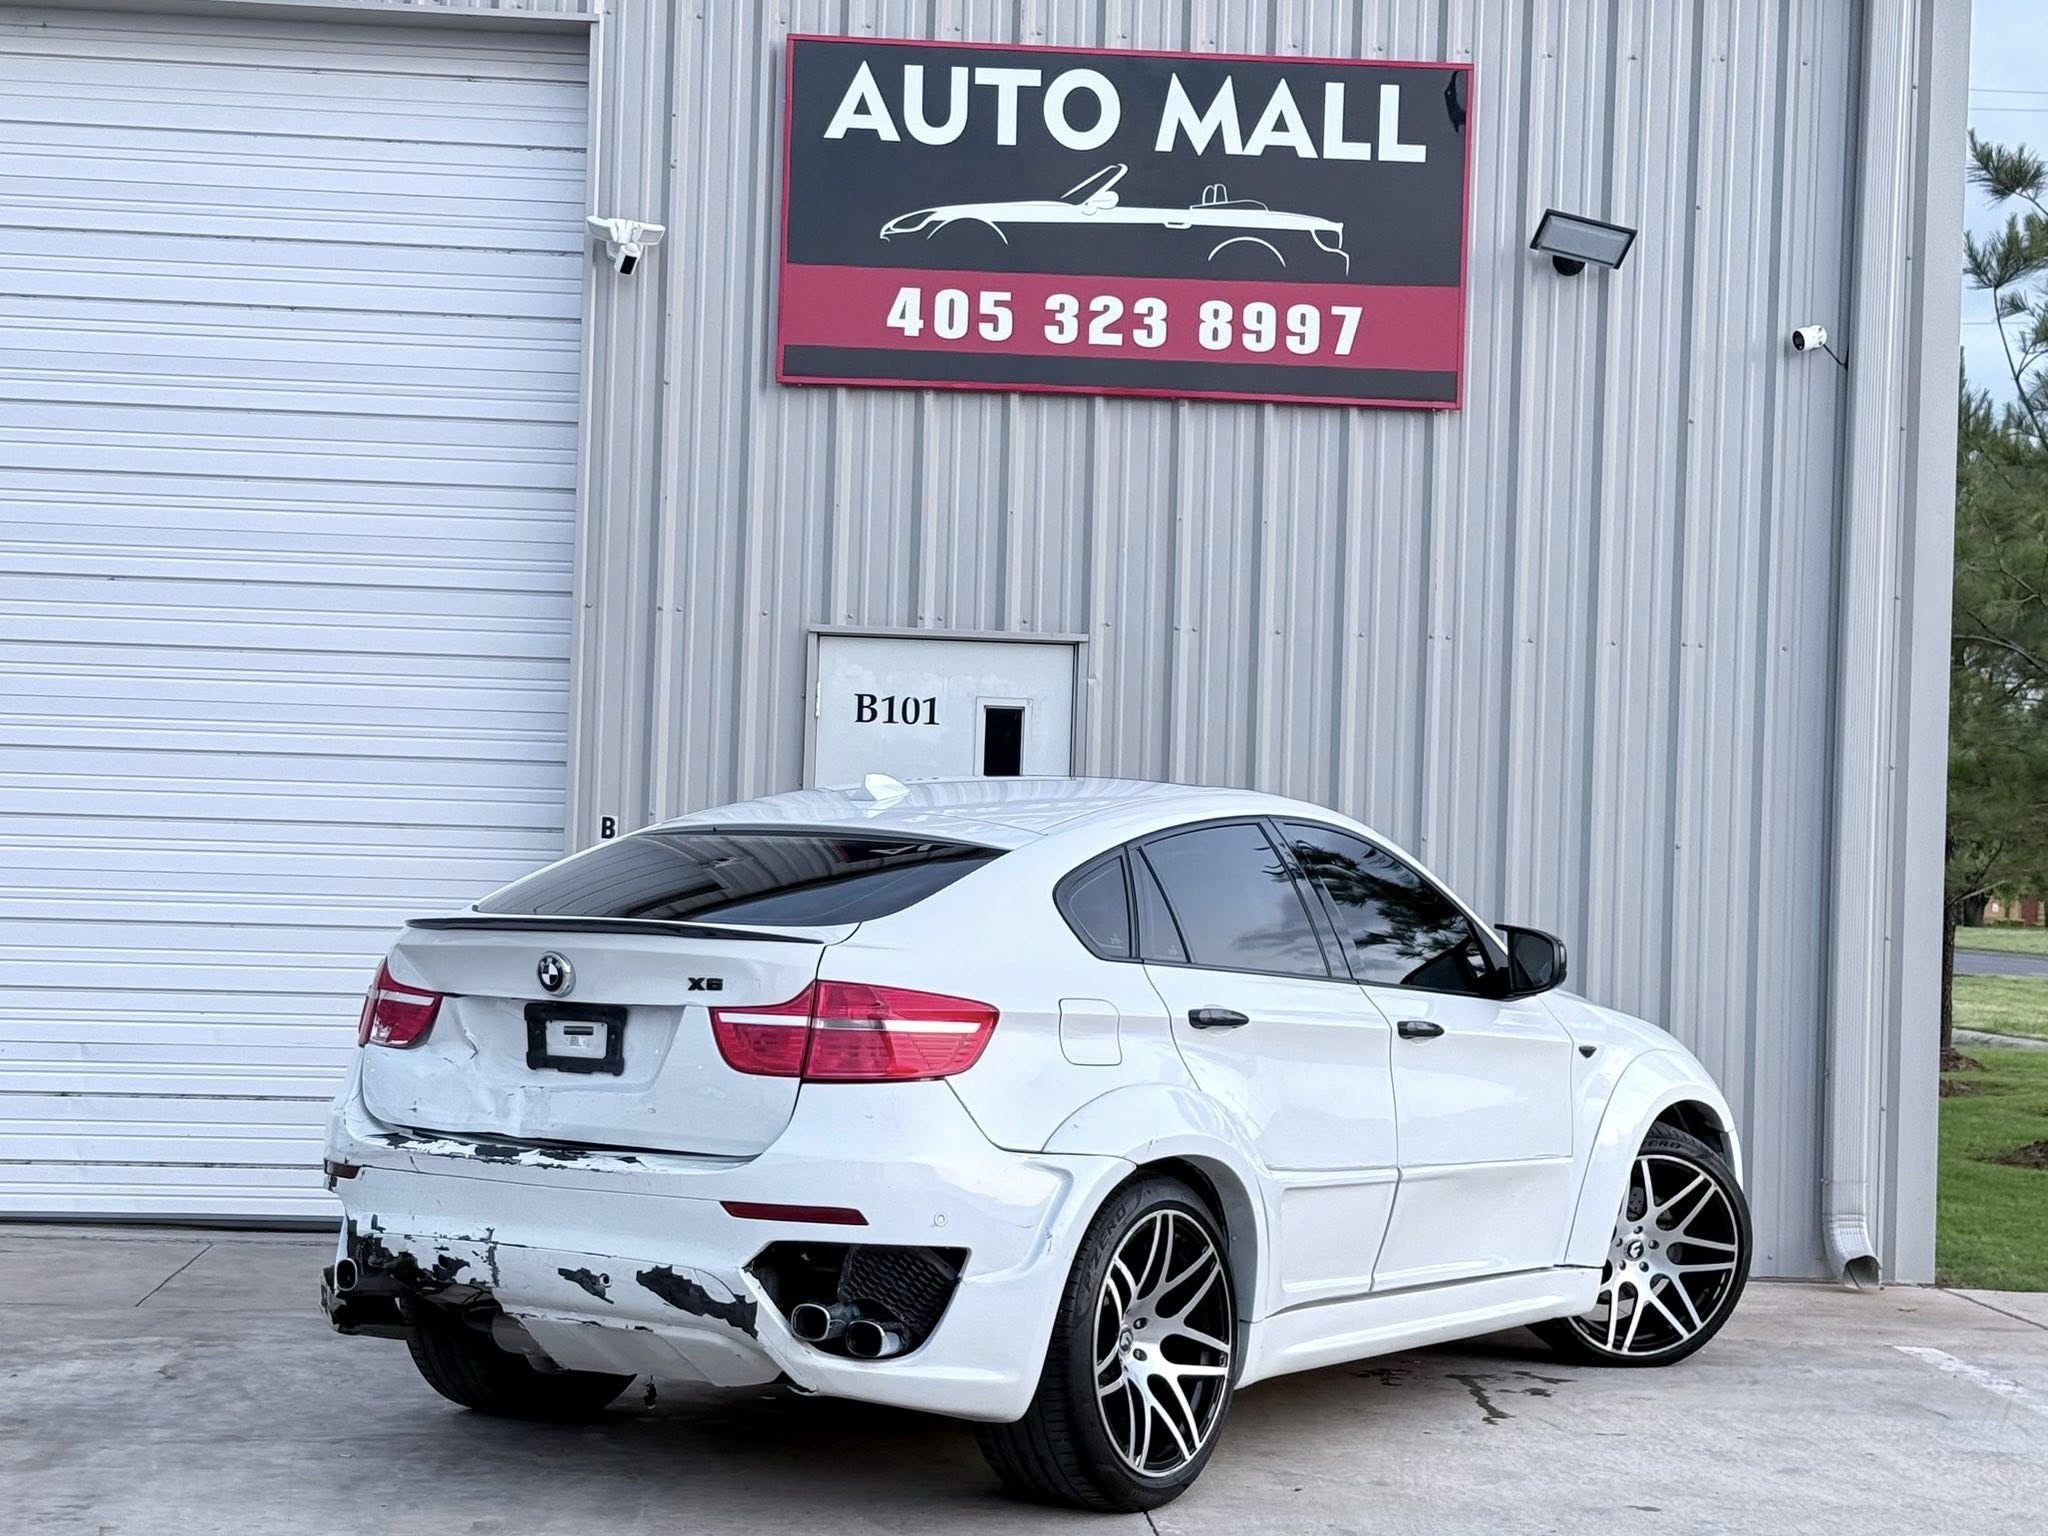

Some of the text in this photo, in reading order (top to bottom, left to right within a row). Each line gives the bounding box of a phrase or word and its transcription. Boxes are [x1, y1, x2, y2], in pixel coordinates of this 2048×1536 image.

[823, 60, 1427, 163] AUTO MALL
[886, 286, 1363, 356] 405 323 8997
[854, 693, 940, 726] B101
[601, 816, 616, 839] B
[687, 977, 724, 992] X6
